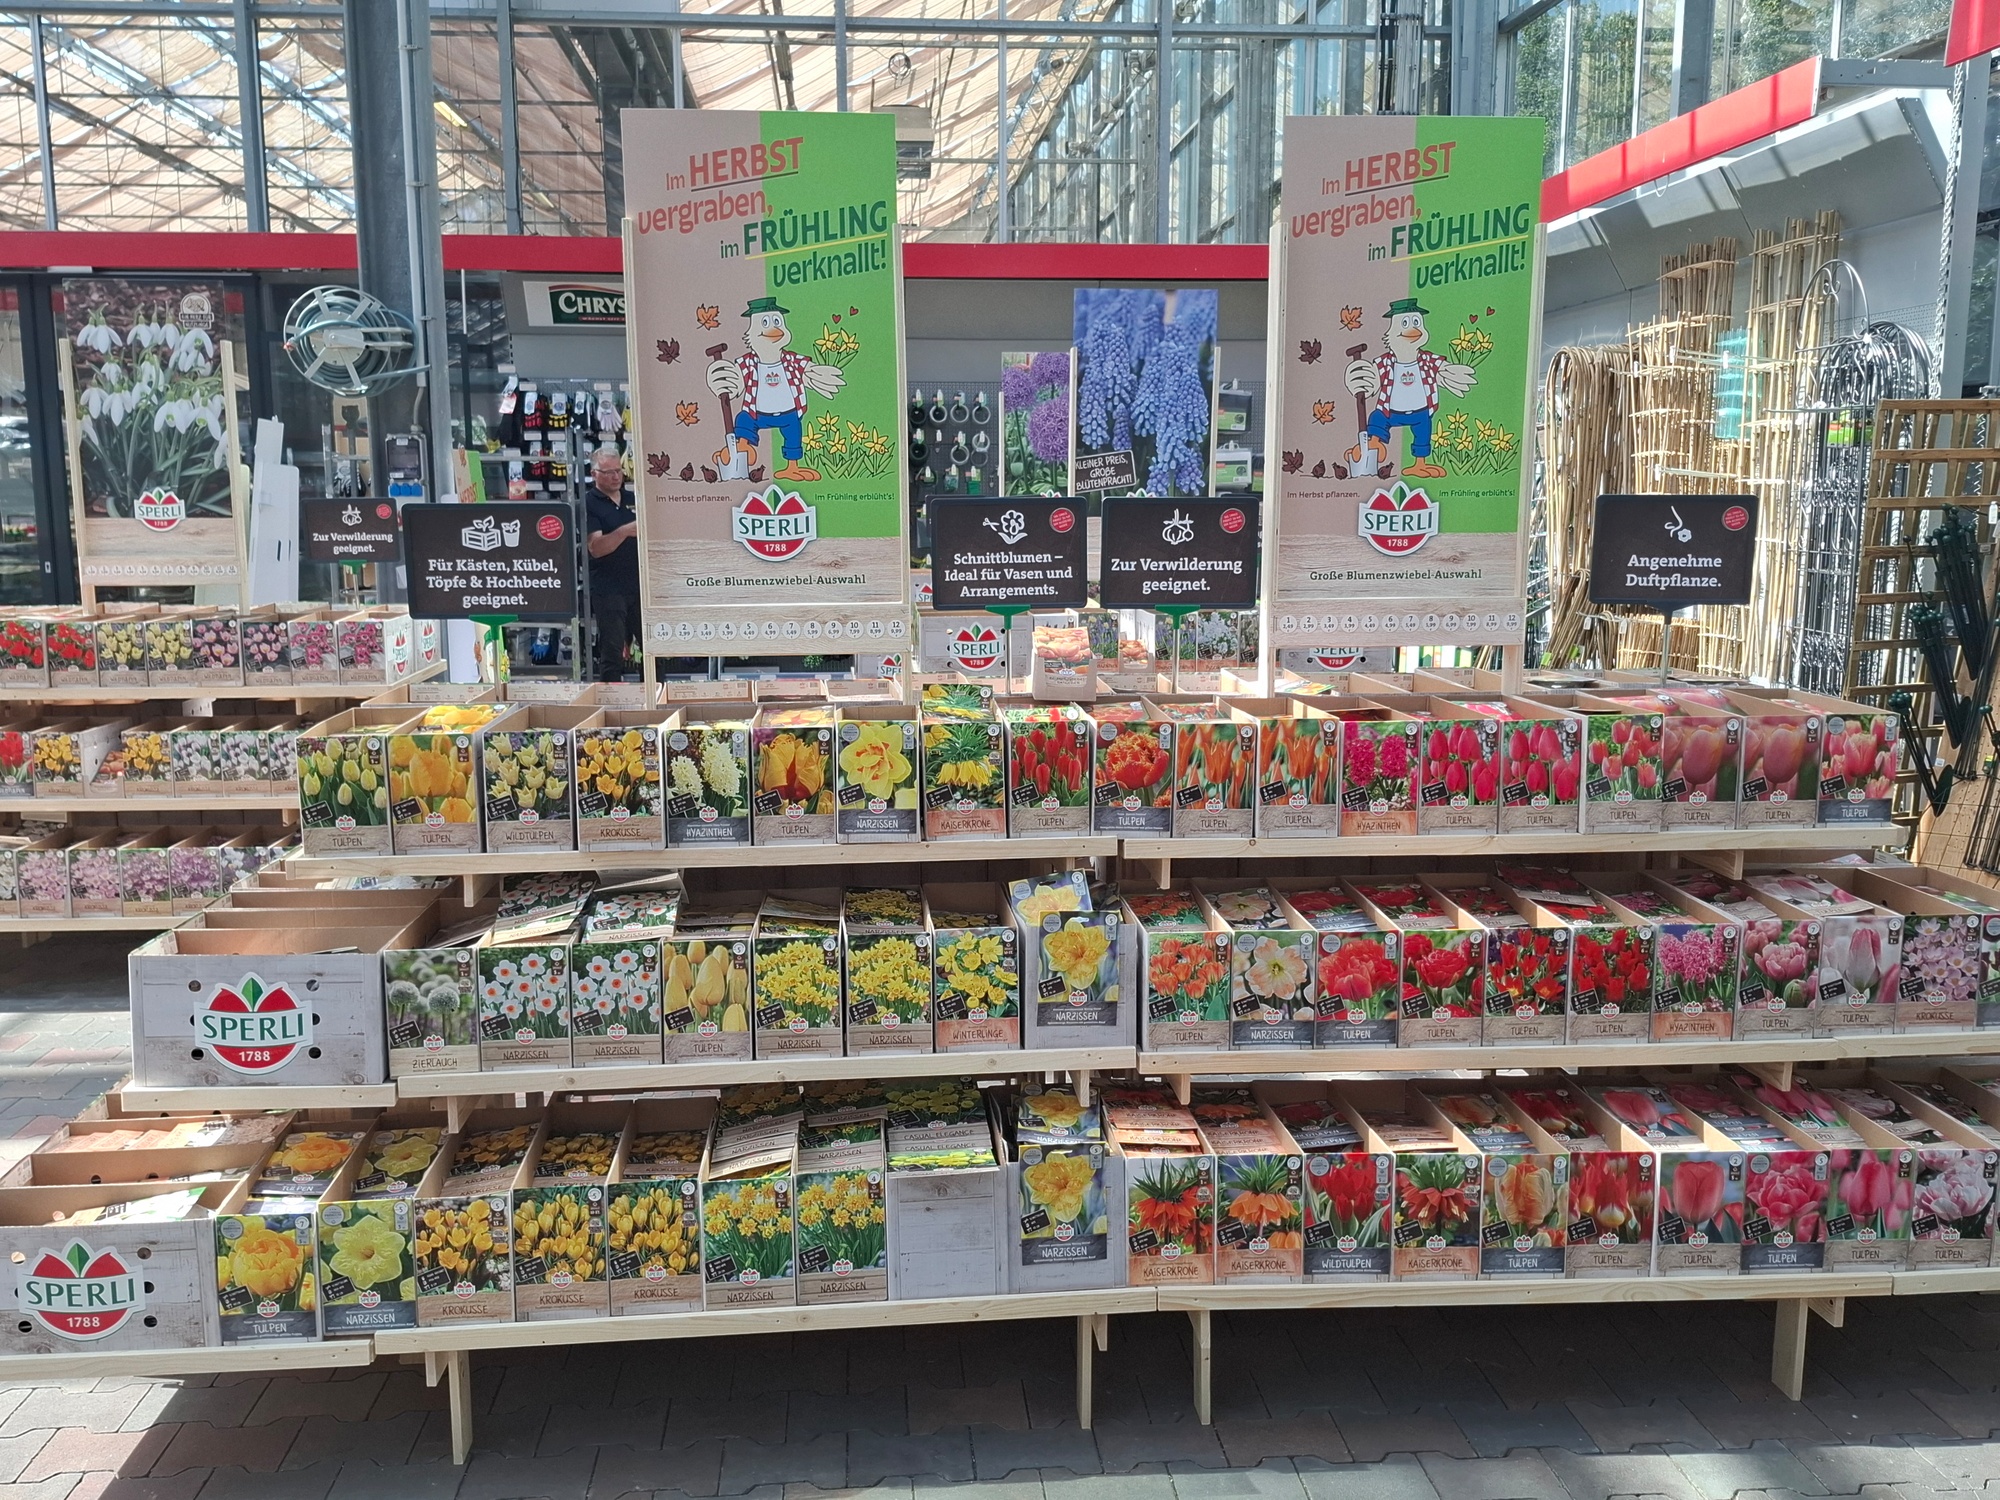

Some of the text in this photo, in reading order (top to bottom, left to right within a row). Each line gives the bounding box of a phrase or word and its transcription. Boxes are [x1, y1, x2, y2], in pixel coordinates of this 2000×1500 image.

[666, 137, 803, 191] Im HERBST
[1322, 142, 1456, 195] Im HERBST
[638, 190, 773, 234] vergraben,
[1292, 194, 1421, 238] vergraben,
[720, 200, 887, 258] im FRÜHLING
[1368, 203, 1529, 261] im FRÜHLING
[773, 240, 886, 287] verknallt!
[1416, 241, 1525, 289] verknallt!
[1076, 474, 1133, 491] BLÜTENPRACHT!
[696, 494, 733, 503] pflanzen.
[827, 493, 857, 502] Frühling
[1325, 491, 1360, 499] pflanzen.
[1451, 489, 1479, 498] Frühling
[138, 505, 181, 517] SPERLI
[739, 516, 810, 537] SPERLI
[1364, 511, 1433, 532] SPERLI
[313, 532, 393, 545] Zur Verwilderung
[1387, 538, 1408, 547] 1788
[333, 544, 375, 555] geeignet.
[764, 543, 787, 552] 1788
[954, 552, 1051, 565] Schnittblumen
[1627, 554, 1722, 570] Angenehme
[428, 559, 558, 574] Für Kästen, Kübel,
[1111, 557, 1243, 574] Zur Verwilderung
[944, 567, 1073, 581] Ideal für Vasen und
[1310, 569, 1481, 581] Große Blumenzwiebel-Auswahl
[426, 575, 561, 591] Töpfe & Hochbeete
[686, 574, 866, 587] Große Blumenzwiebel-Auswahl
[1625, 573, 1722, 590] Duftpflanze.
[960, 584, 1058, 599] Arrangements.
[1142, 578, 1211, 595] geeignet.
[462, 593, 528, 608] geeignet.
[953, 641, 999, 656] SPERLI
[1610, 810, 1637, 820] TULPEN
[1684, 811, 1710, 821] TULPEN
[1765, 811, 1790, 820] TULPEN
[1842, 809, 1868, 818] TULPEN
[1037, 818, 1065, 827] TULPEN
[1118, 816, 1145, 826] TULPEN
[1201, 819, 1227, 828] TULPEN
[1285, 815, 1312, 825] TULPEN
[1446, 816, 1472, 824] TULPEN
[1527, 816, 1553, 824] TULPEN
[600, 828, 641, 837] KROKUSSE
[782, 825, 809, 834] TULPEN
[333, 837, 362, 847] TULPEN
[422, 834, 451, 843] TULPEN
[1842, 1014, 1869, 1023] TULPEN
[1916, 1012, 1954, 1021] KROKUSSE
[202, 1013, 304, 1041] SPERLI
[1762, 1018, 1789, 1028] TULPEN
[1427, 1028, 1455, 1037] TULPEN
[1511, 1026, 1538, 1035] TULPEN
[1596, 1024, 1623, 1033] TULPEN
[1174, 1032, 1203, 1041] TULPEN
[1343, 1030, 1371, 1039] TULPEN
[693, 1043, 723, 1052] TULPEN
[239, 1051, 271, 1062] 1788
[1768, 1253, 1797, 1264] TULPEN
[1852, 1250, 1880, 1259] TULPEN
[1935, 1249, 1963, 1258] TULPEN
[1508, 1258, 1537, 1268] TULPEN
[1594, 1254, 1622, 1264] TULPEN
[1683, 1254, 1712, 1264] TULPEN
[26, 1278, 135, 1307] SPERLI
[634, 1288, 679, 1299] KROKUSSE
[539, 1293, 584, 1304] KROKUSSE
[442, 1304, 488, 1316] KROKUSSE
[67, 1317, 100, 1328] 1788
[253, 1323, 286, 1333] TULPEN
